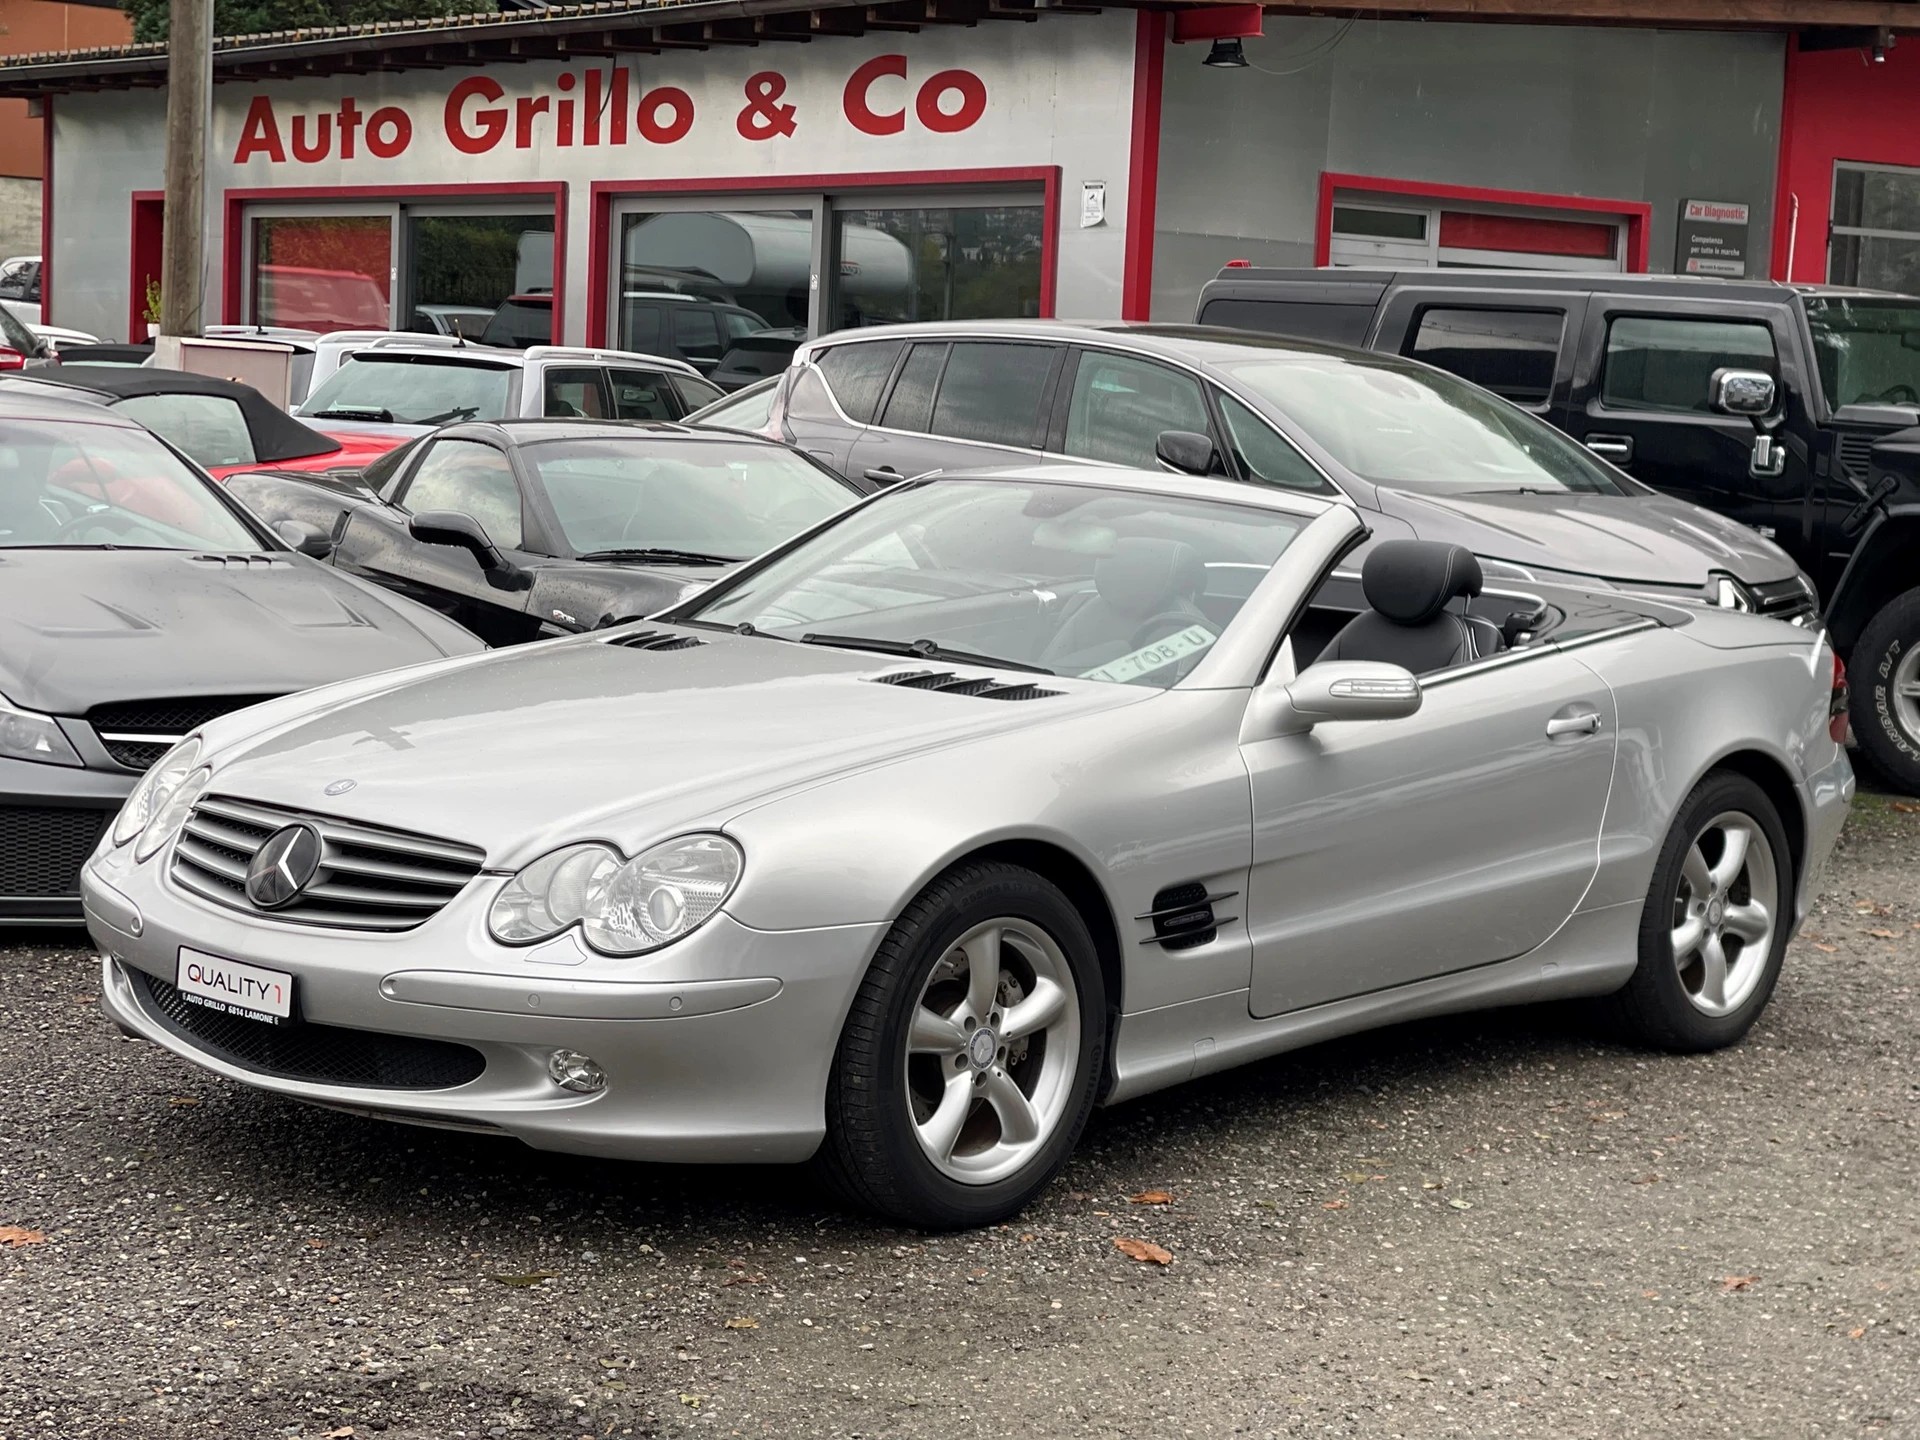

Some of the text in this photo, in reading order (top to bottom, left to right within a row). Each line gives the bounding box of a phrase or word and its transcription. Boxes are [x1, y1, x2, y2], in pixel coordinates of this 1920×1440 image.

[233, 54, 988, 164] Auto Grillo & Co
[1690, 204, 1746, 221] Car Diagnostic
[186, 995, 274, 1024] AUTO GRILLO 6814 LAMONE
